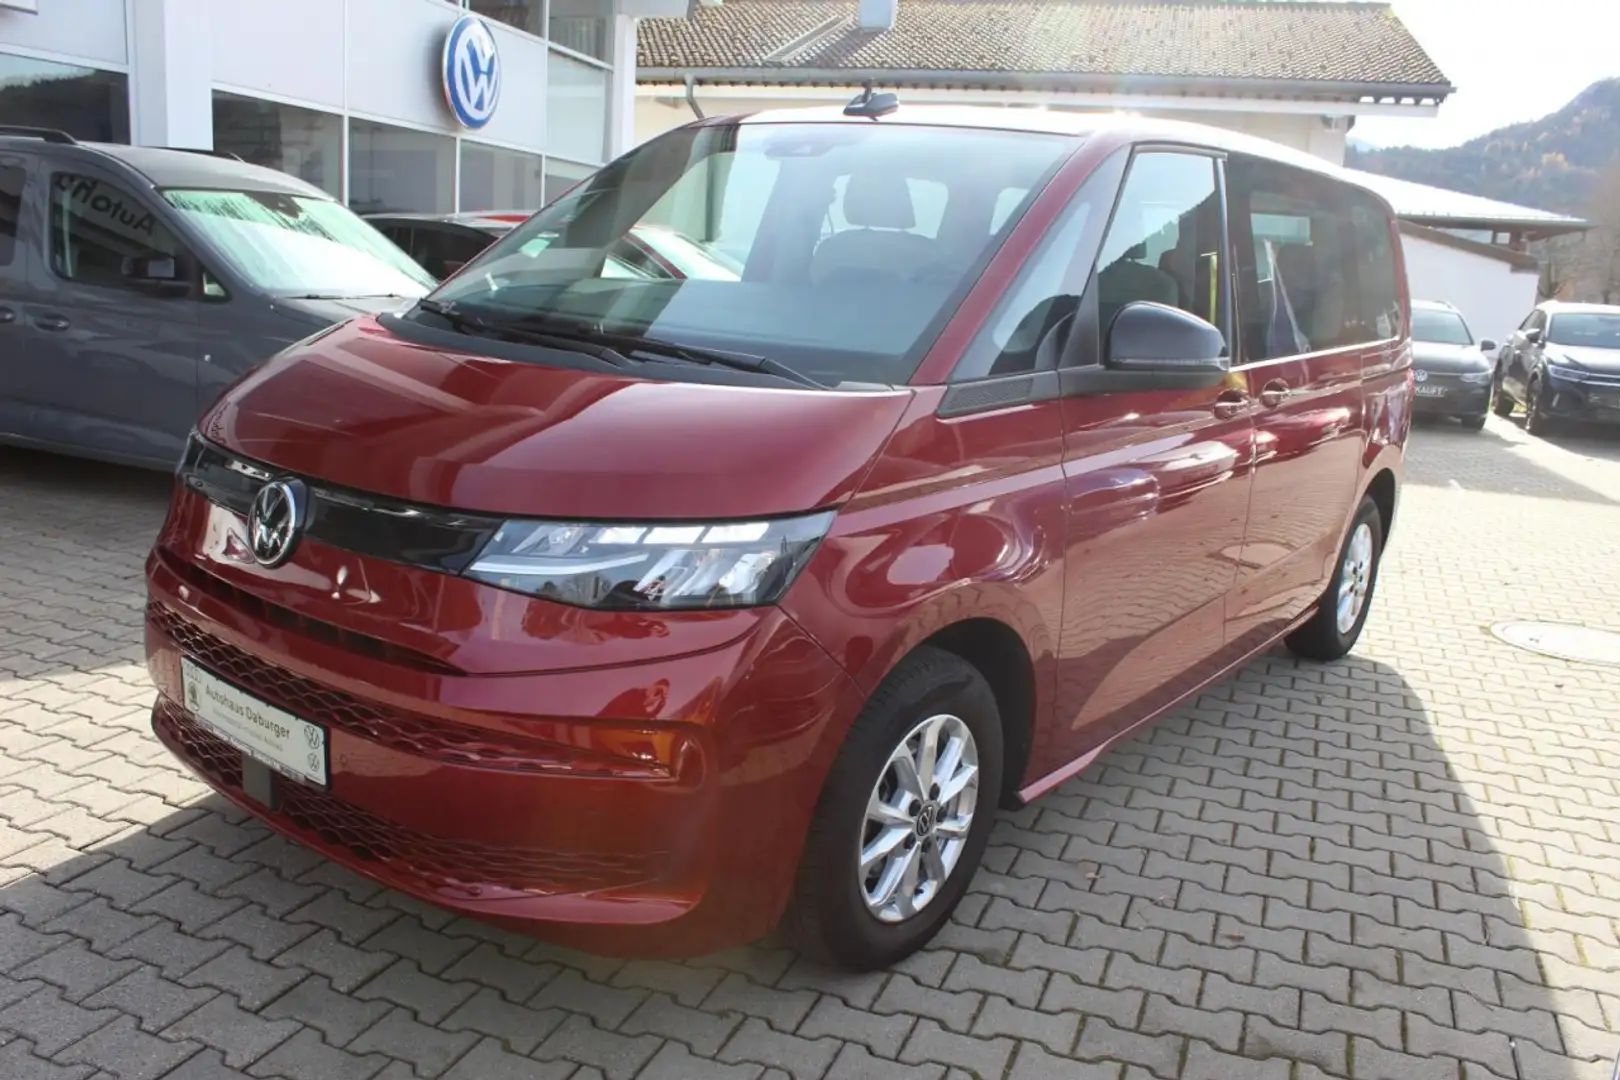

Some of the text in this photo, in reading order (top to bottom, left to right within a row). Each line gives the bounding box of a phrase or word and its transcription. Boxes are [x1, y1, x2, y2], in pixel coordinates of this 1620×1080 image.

[448, 19, 498, 126] VW
[251, 481, 295, 565] VW
[205, 684, 244, 717] Autohaus
[245, 706, 291, 739] Daburger
